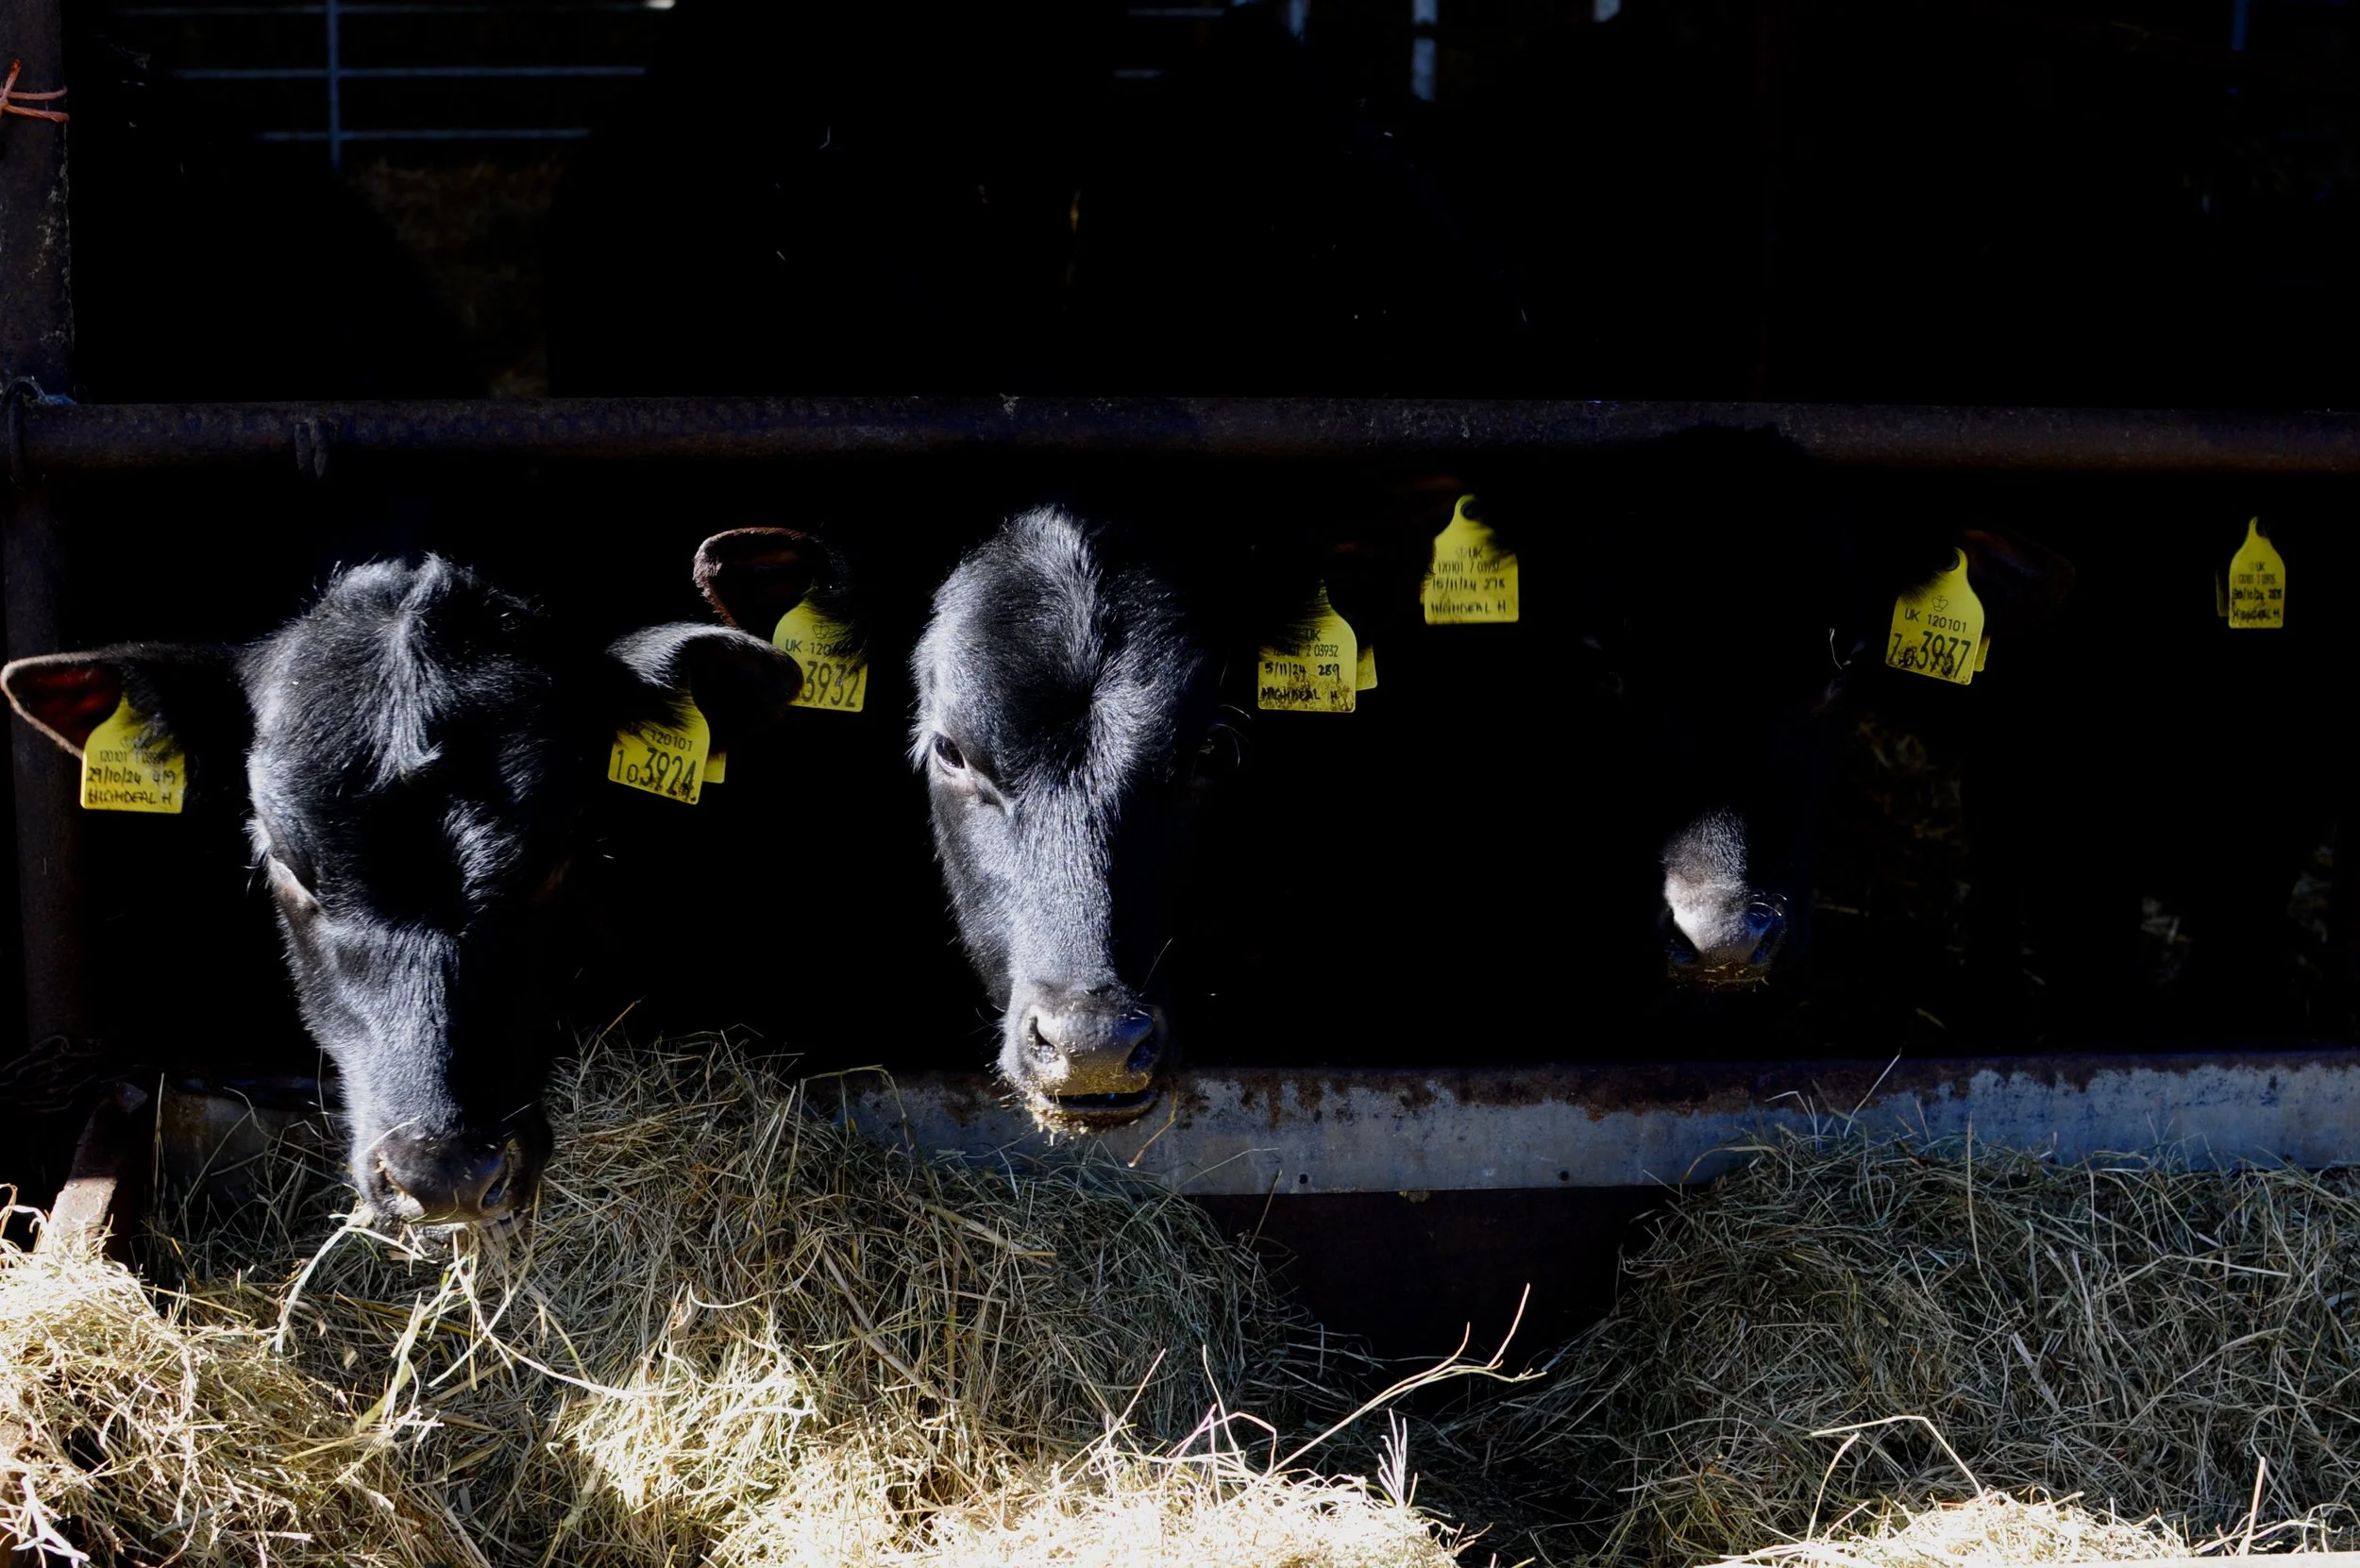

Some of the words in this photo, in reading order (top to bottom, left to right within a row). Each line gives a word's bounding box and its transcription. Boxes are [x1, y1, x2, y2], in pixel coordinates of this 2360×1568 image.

[1469, 546, 1483, 559] UK
[1498, 599, 1506, 613] H
[1904, 608, 1921, 623] UK
[1928, 614, 1966, 633] 120101
[785, 639, 802, 653] UK
[1313, 644, 1339, 658] 03932
[1318, 664, 1340, 682] 289
[651, 730, 693, 751] 120101
[161, 792, 172, 805] H
